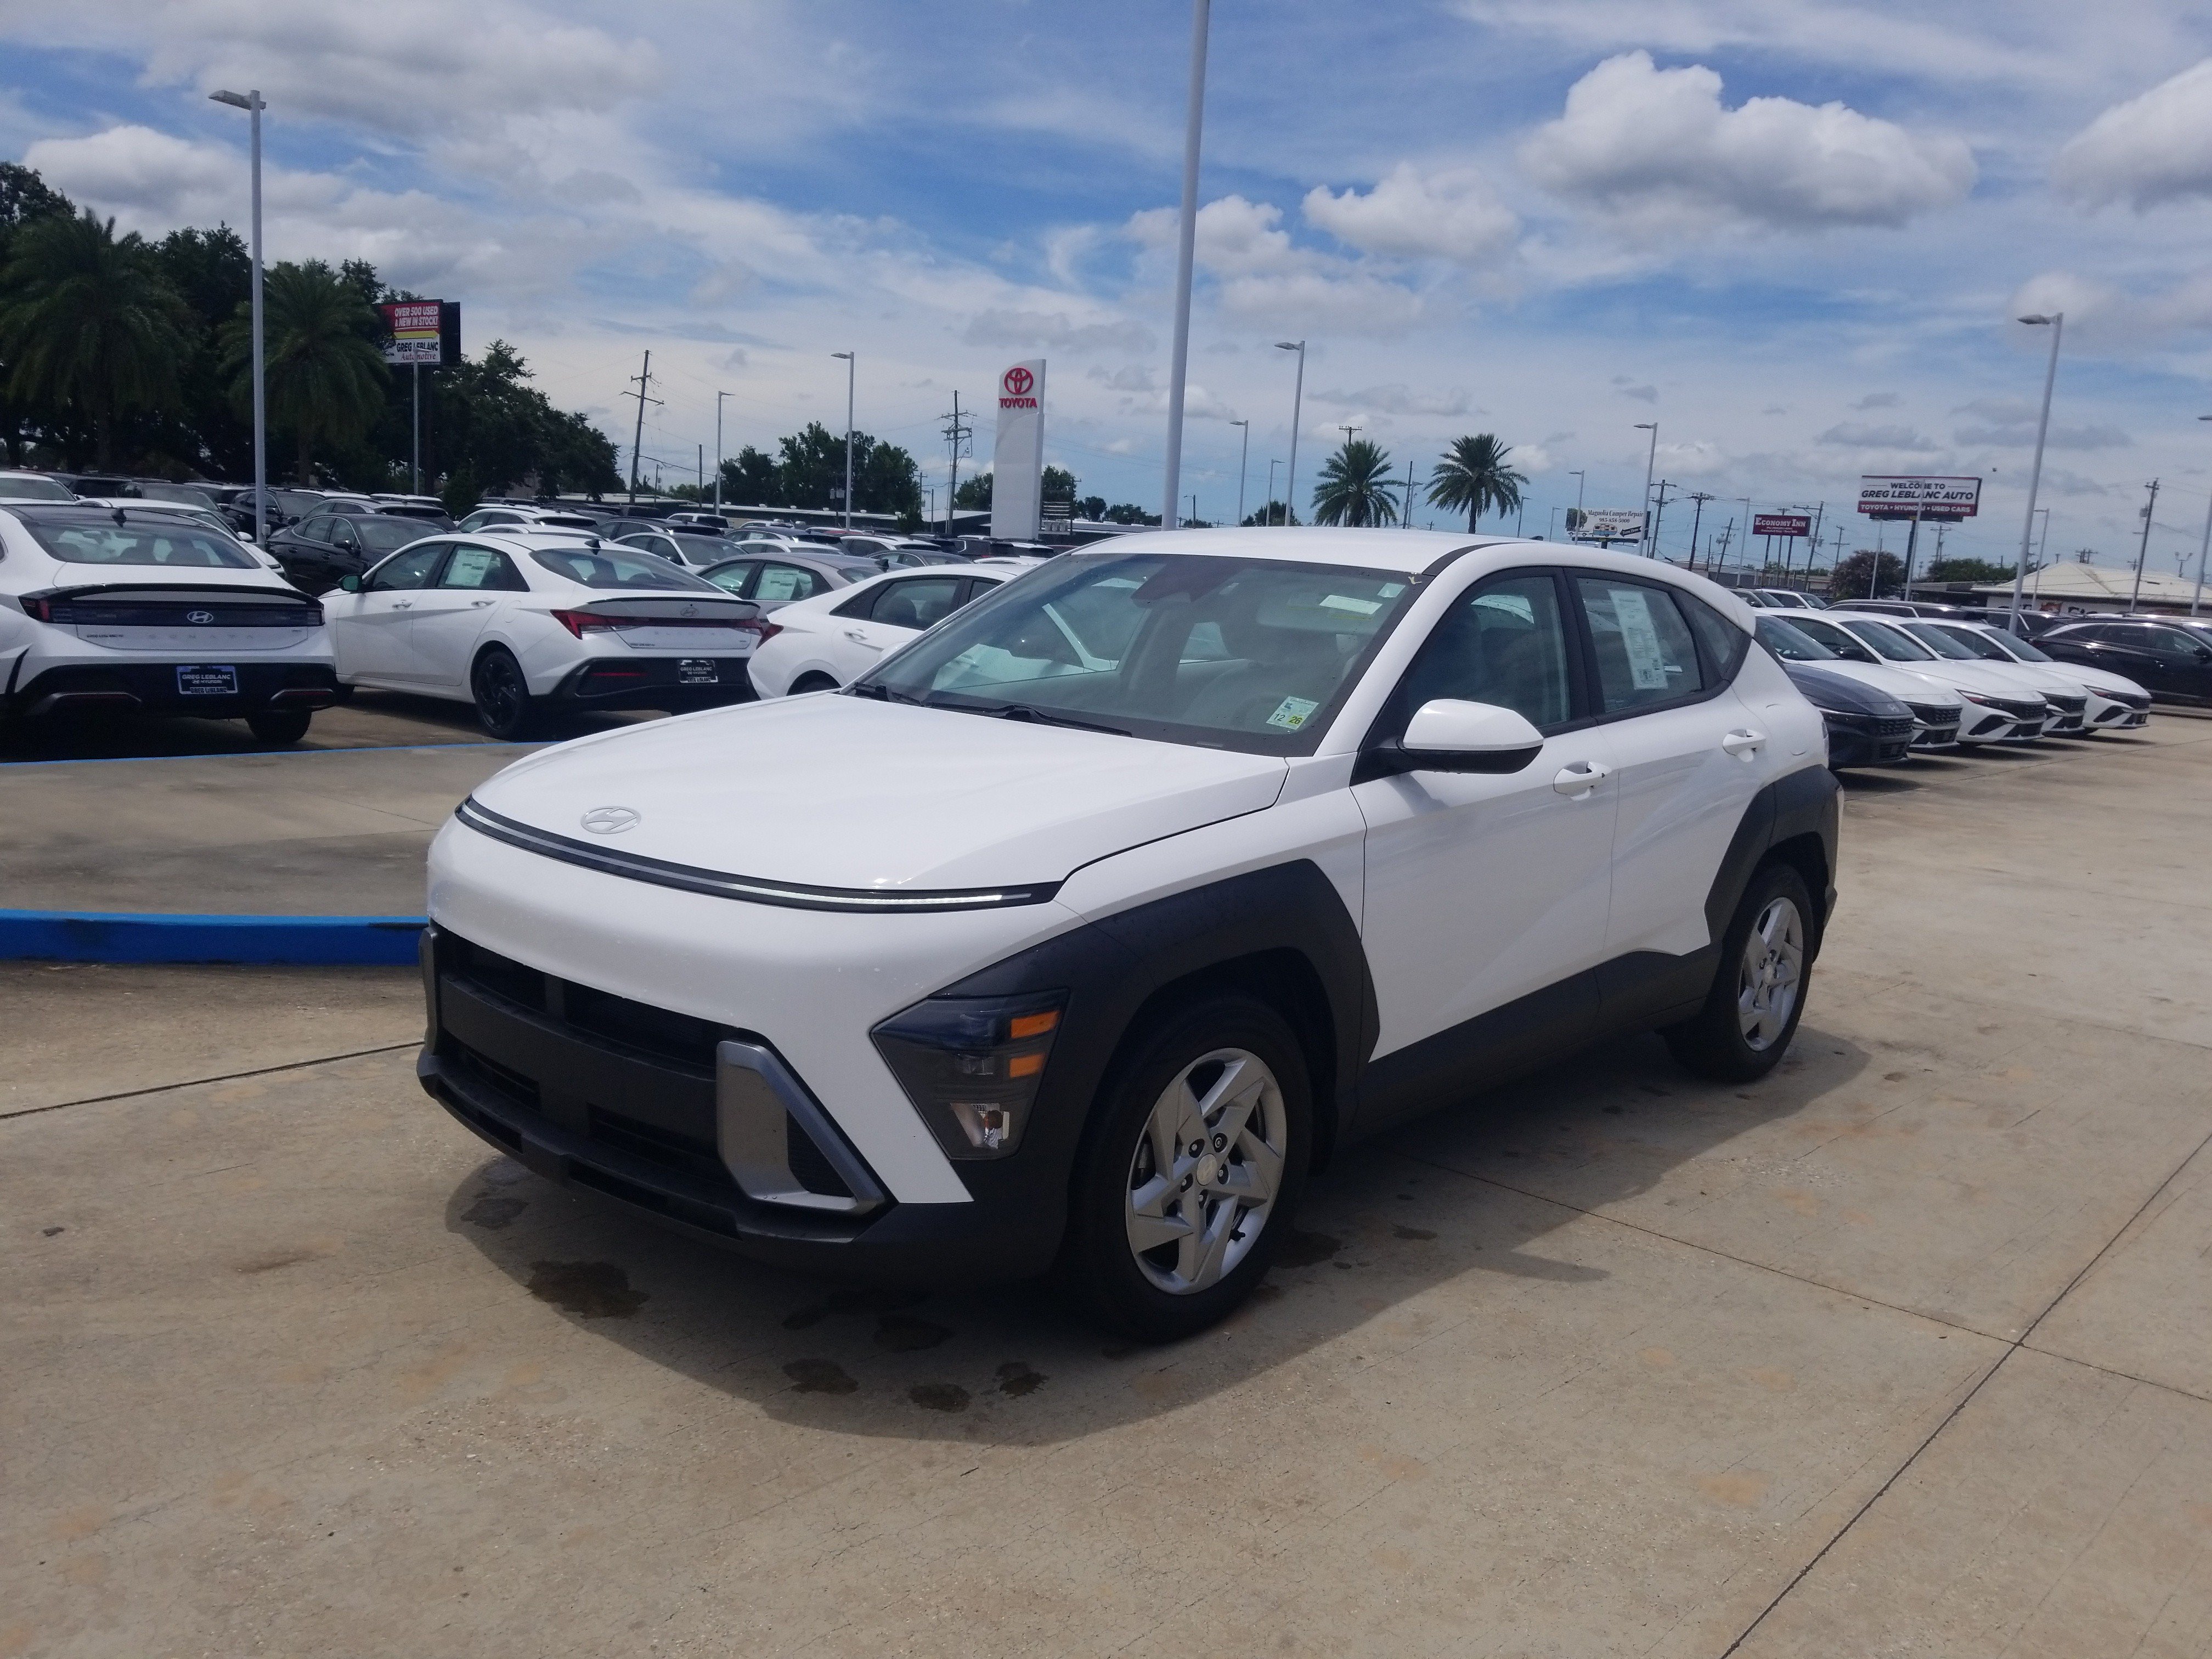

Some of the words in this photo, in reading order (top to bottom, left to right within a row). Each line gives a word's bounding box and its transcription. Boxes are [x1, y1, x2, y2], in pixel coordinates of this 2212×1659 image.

[395, 307, 410, 317] OVER
[410, 306, 422, 316] 500
[422, 306, 438, 315] USED
[398, 317, 411, 326] NEW
[411, 317, 418, 326] IN
[397, 342, 412, 352] GREG
[999, 397, 1037, 408] TOYOTA
[1861, 490, 1889, 498] GREG
[1943, 491, 1974, 500] AUTO
[1756, 517, 1791, 527] ECONOMY
[1274, 713, 1285, 721] 12
[1288, 716, 1302, 724] 26
